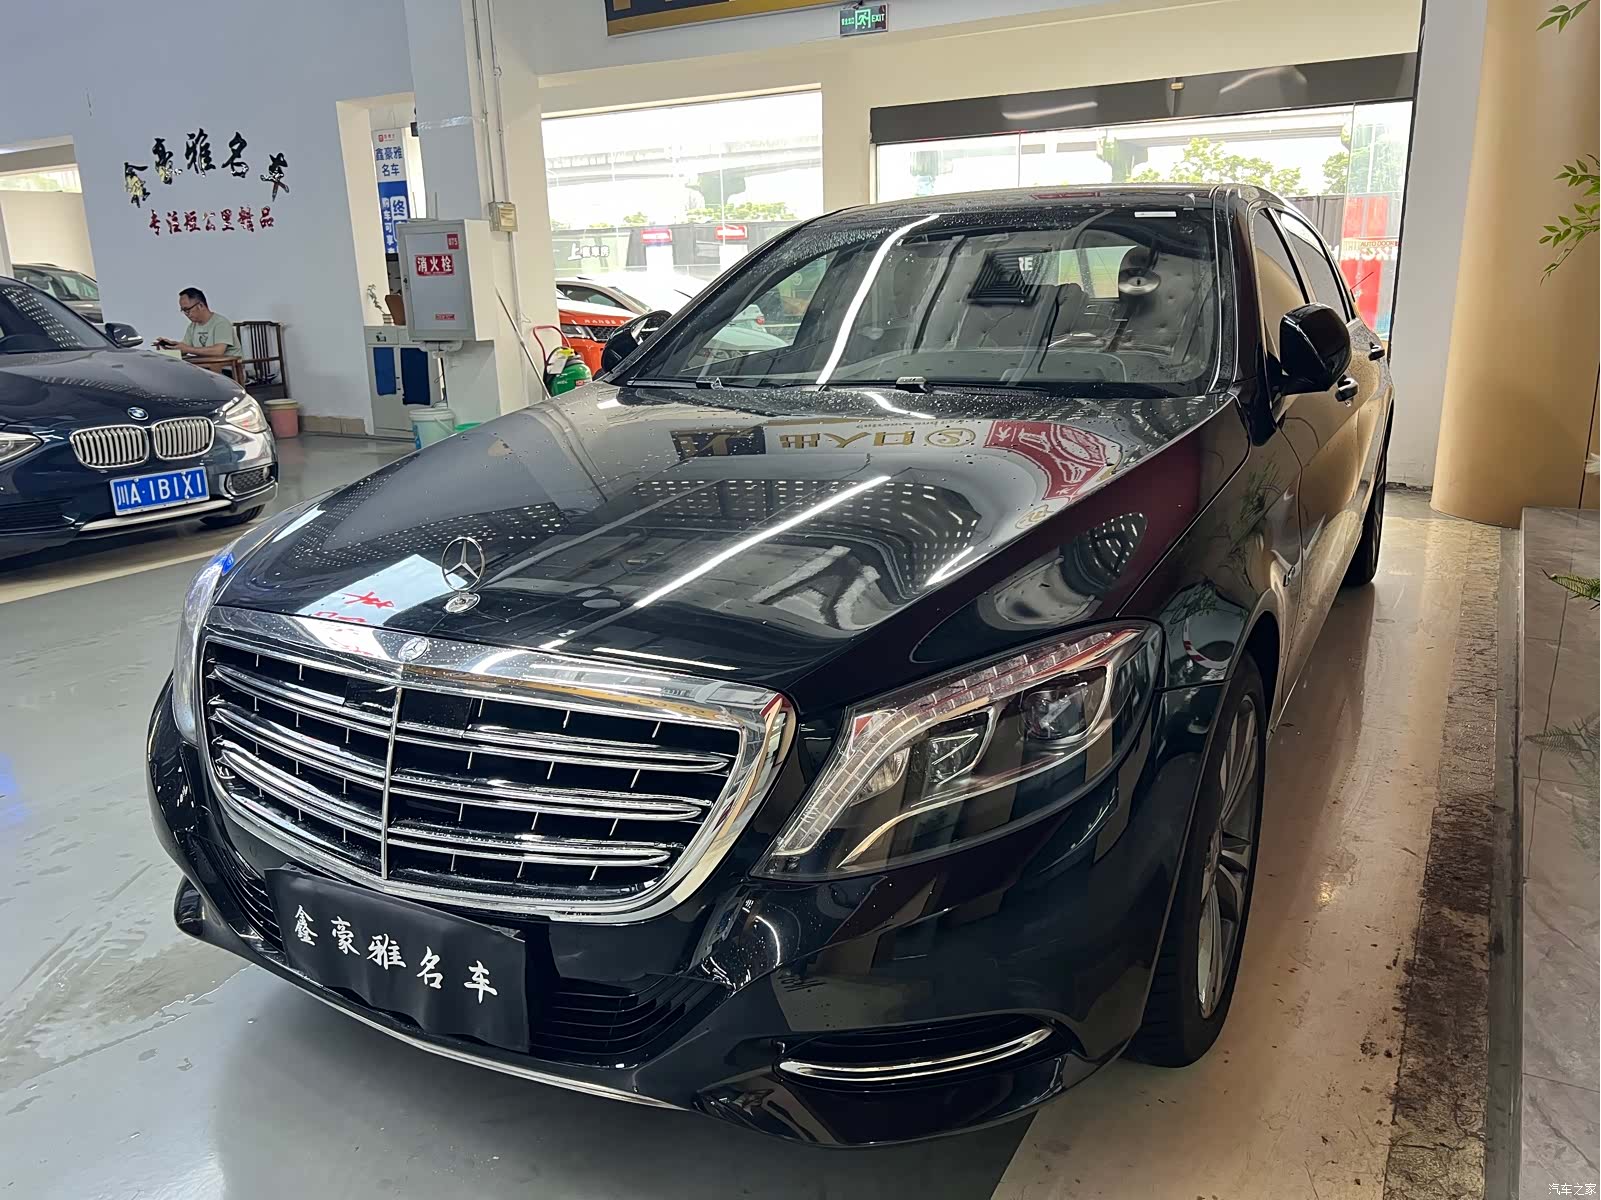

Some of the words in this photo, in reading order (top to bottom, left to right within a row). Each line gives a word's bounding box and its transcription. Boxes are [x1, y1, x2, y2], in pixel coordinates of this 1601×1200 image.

[872, 14, 885, 22] EXIT
[374, 146, 403, 161] 鑫豪雅
[381, 163, 400, 177] 名车
[417, 255, 452, 272] 消火栓
[294, 904, 498, 1004] 鑫豪雅名车
